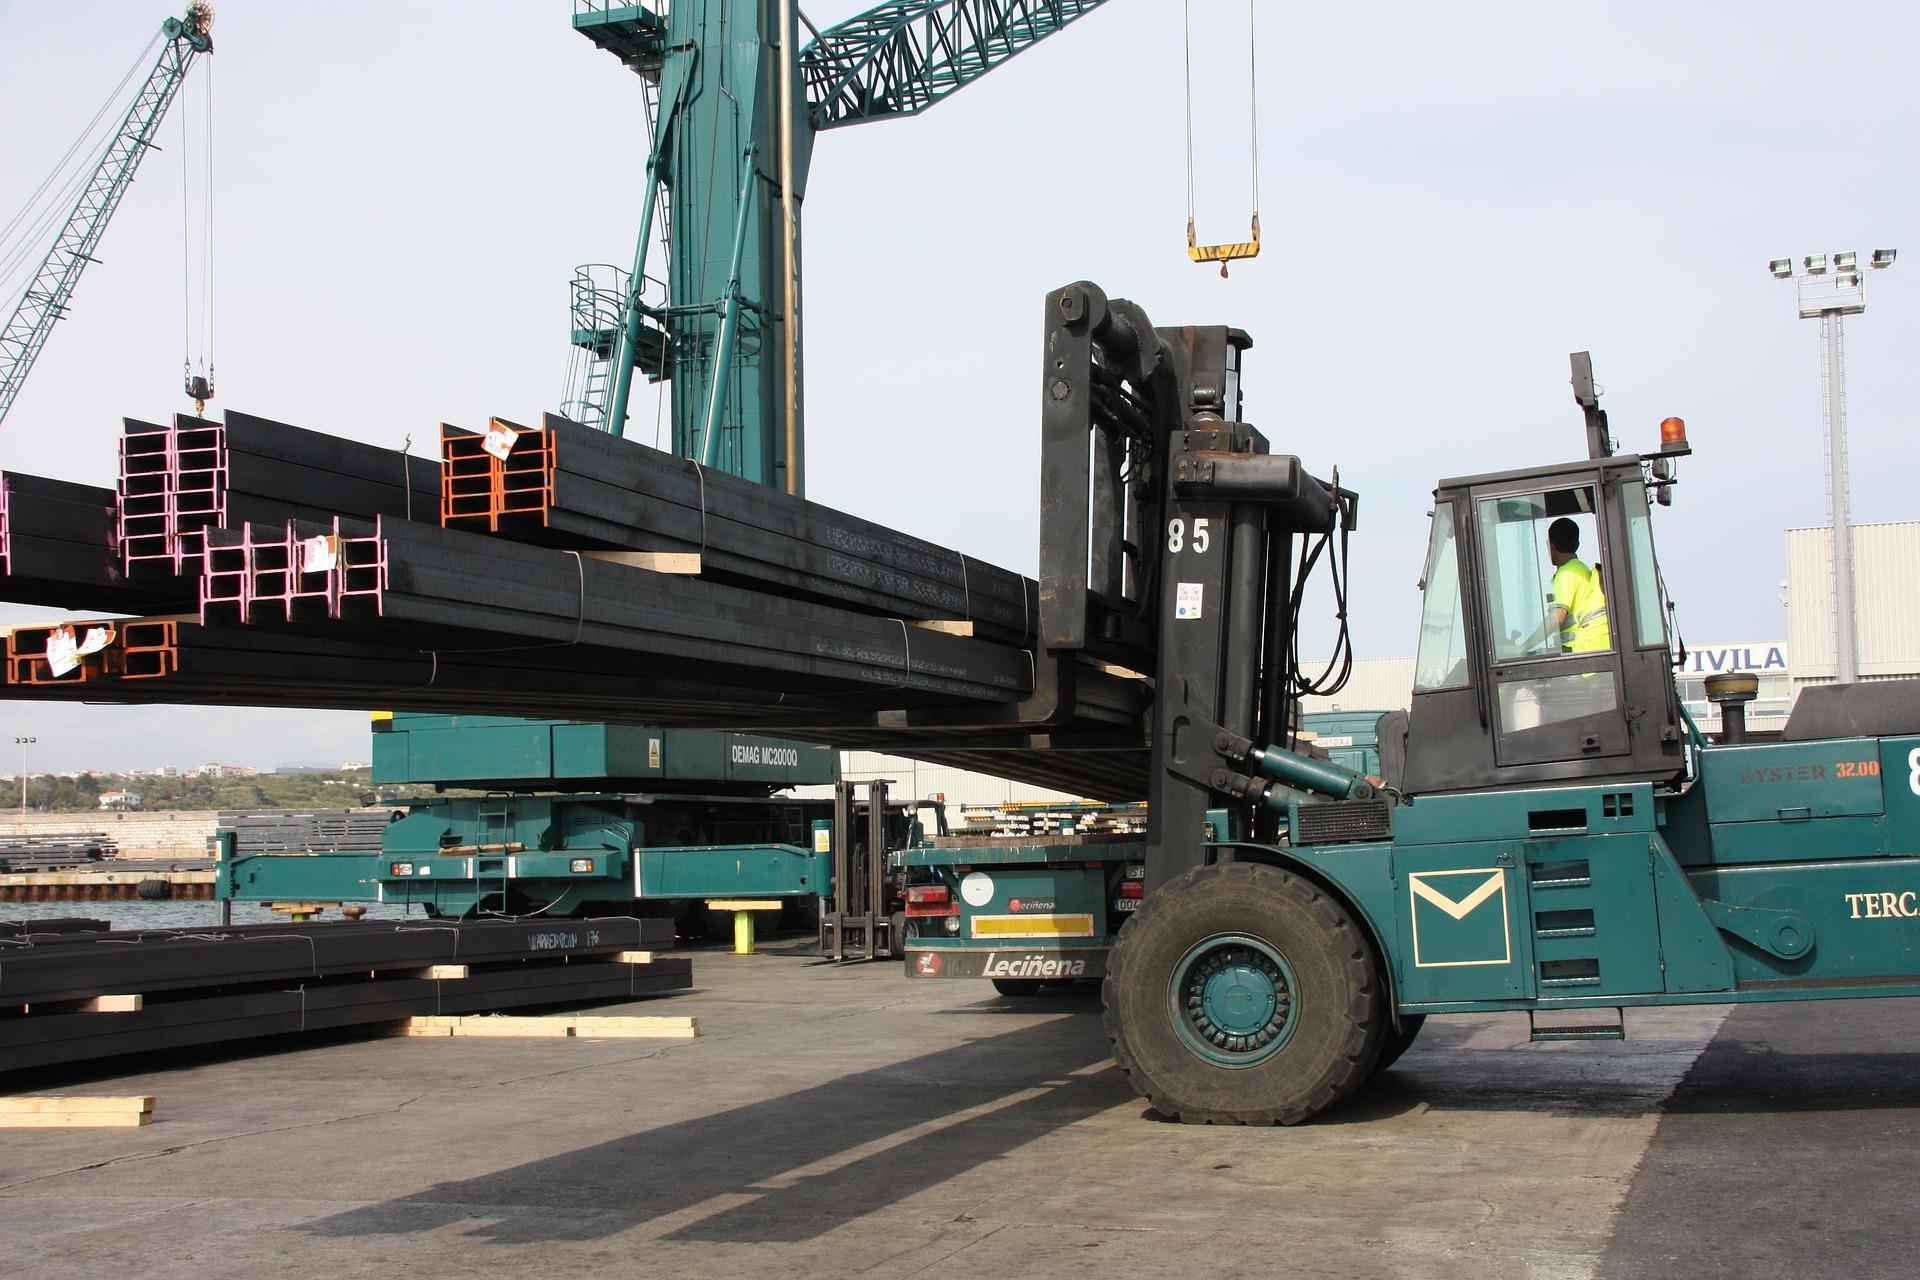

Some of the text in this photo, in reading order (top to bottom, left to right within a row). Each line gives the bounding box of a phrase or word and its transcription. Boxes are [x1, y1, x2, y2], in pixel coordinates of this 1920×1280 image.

[1168, 518, 1210, 553] 85
[732, 745, 760, 764] DEMAG
[1835, 760, 1880, 779] 32.00
[1845, 891, 1920, 919] TERC
[982, 952, 1086, 977] Leciñena
